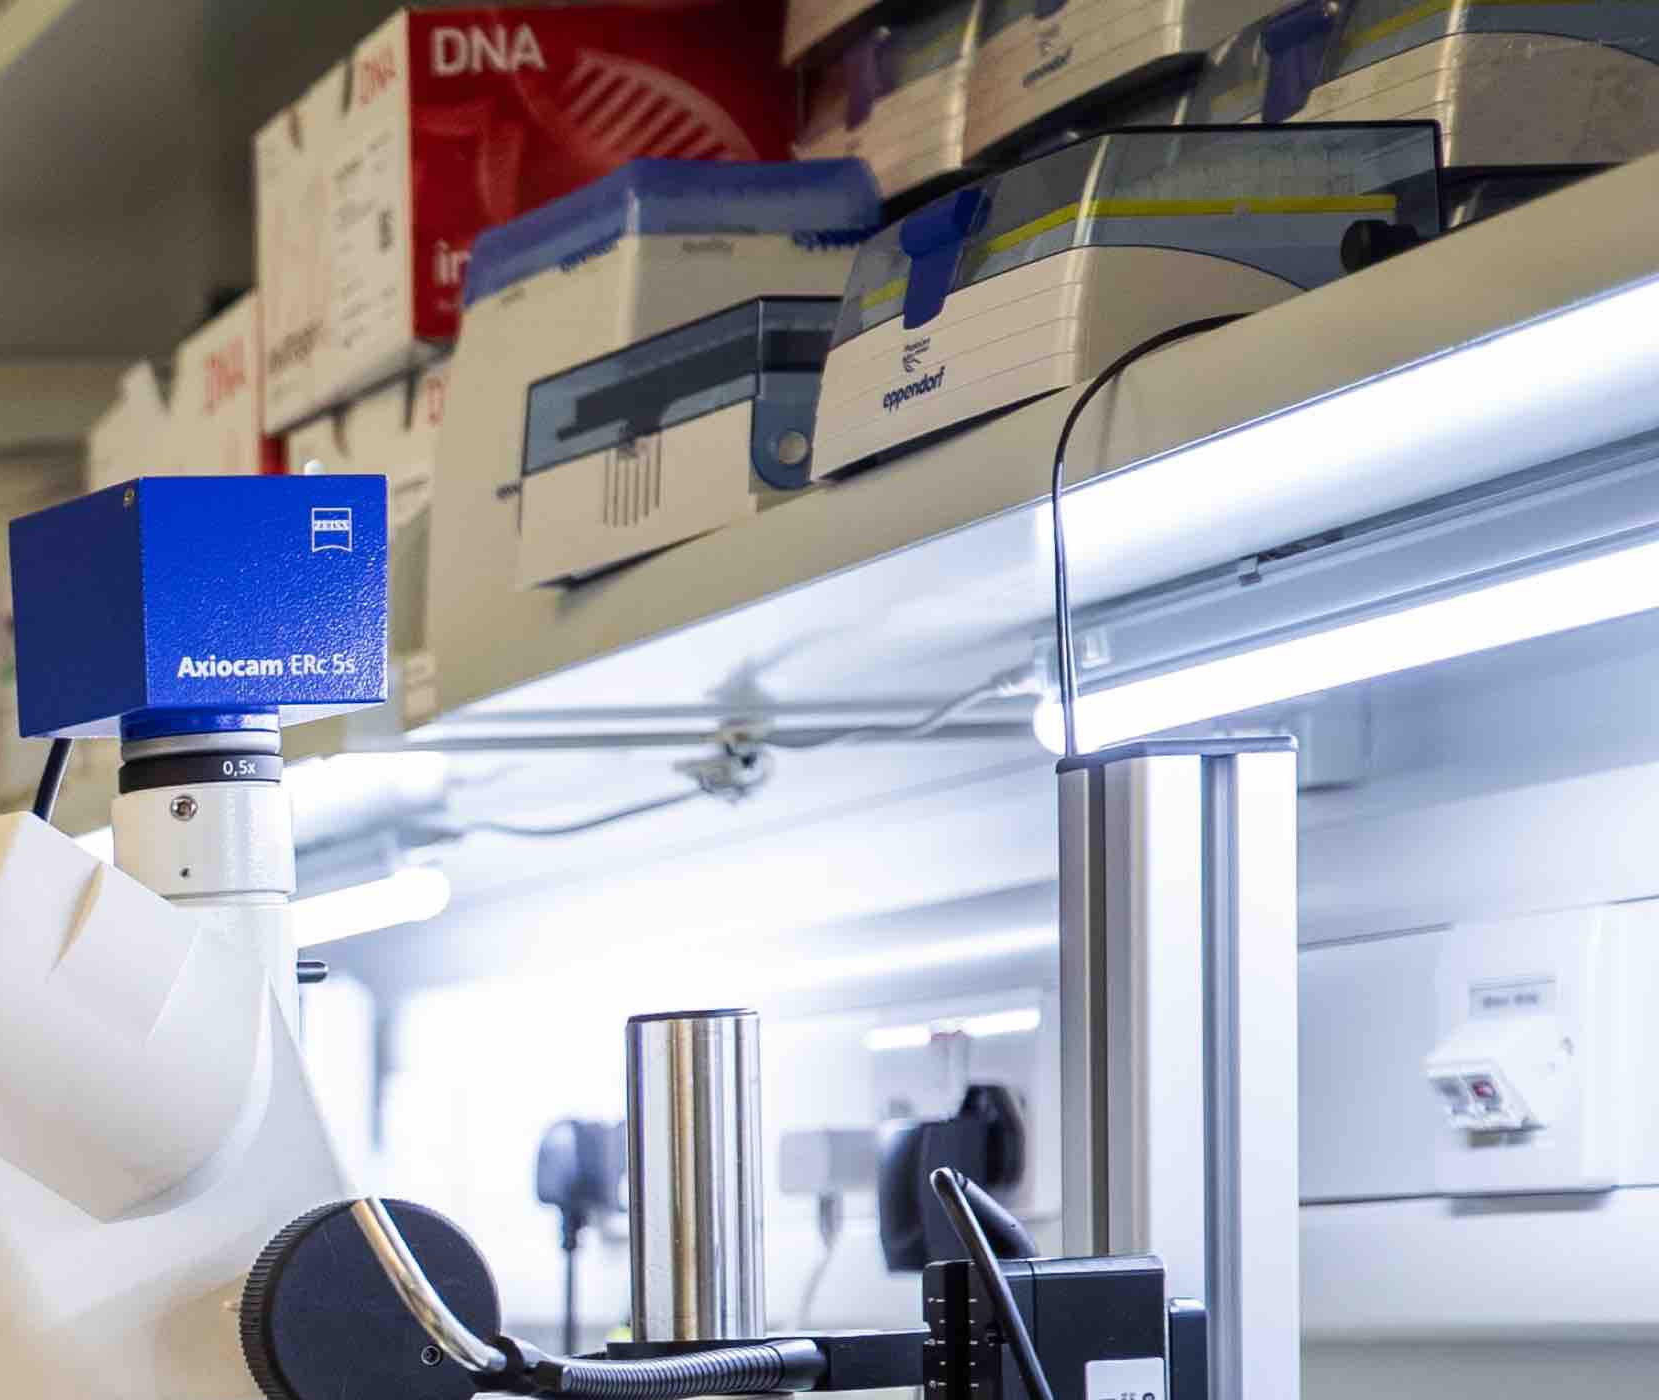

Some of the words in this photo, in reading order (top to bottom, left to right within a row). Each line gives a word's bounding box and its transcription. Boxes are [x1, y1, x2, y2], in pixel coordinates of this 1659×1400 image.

[431, 23, 546, 77] DNA
[883, 365, 945, 413] eppendorf
[177, 655, 284, 679] Axiocam
[290, 653, 327, 675] ERc
[332, 653, 356, 675] 5s
[222, 759, 257, 777] 0,5x
